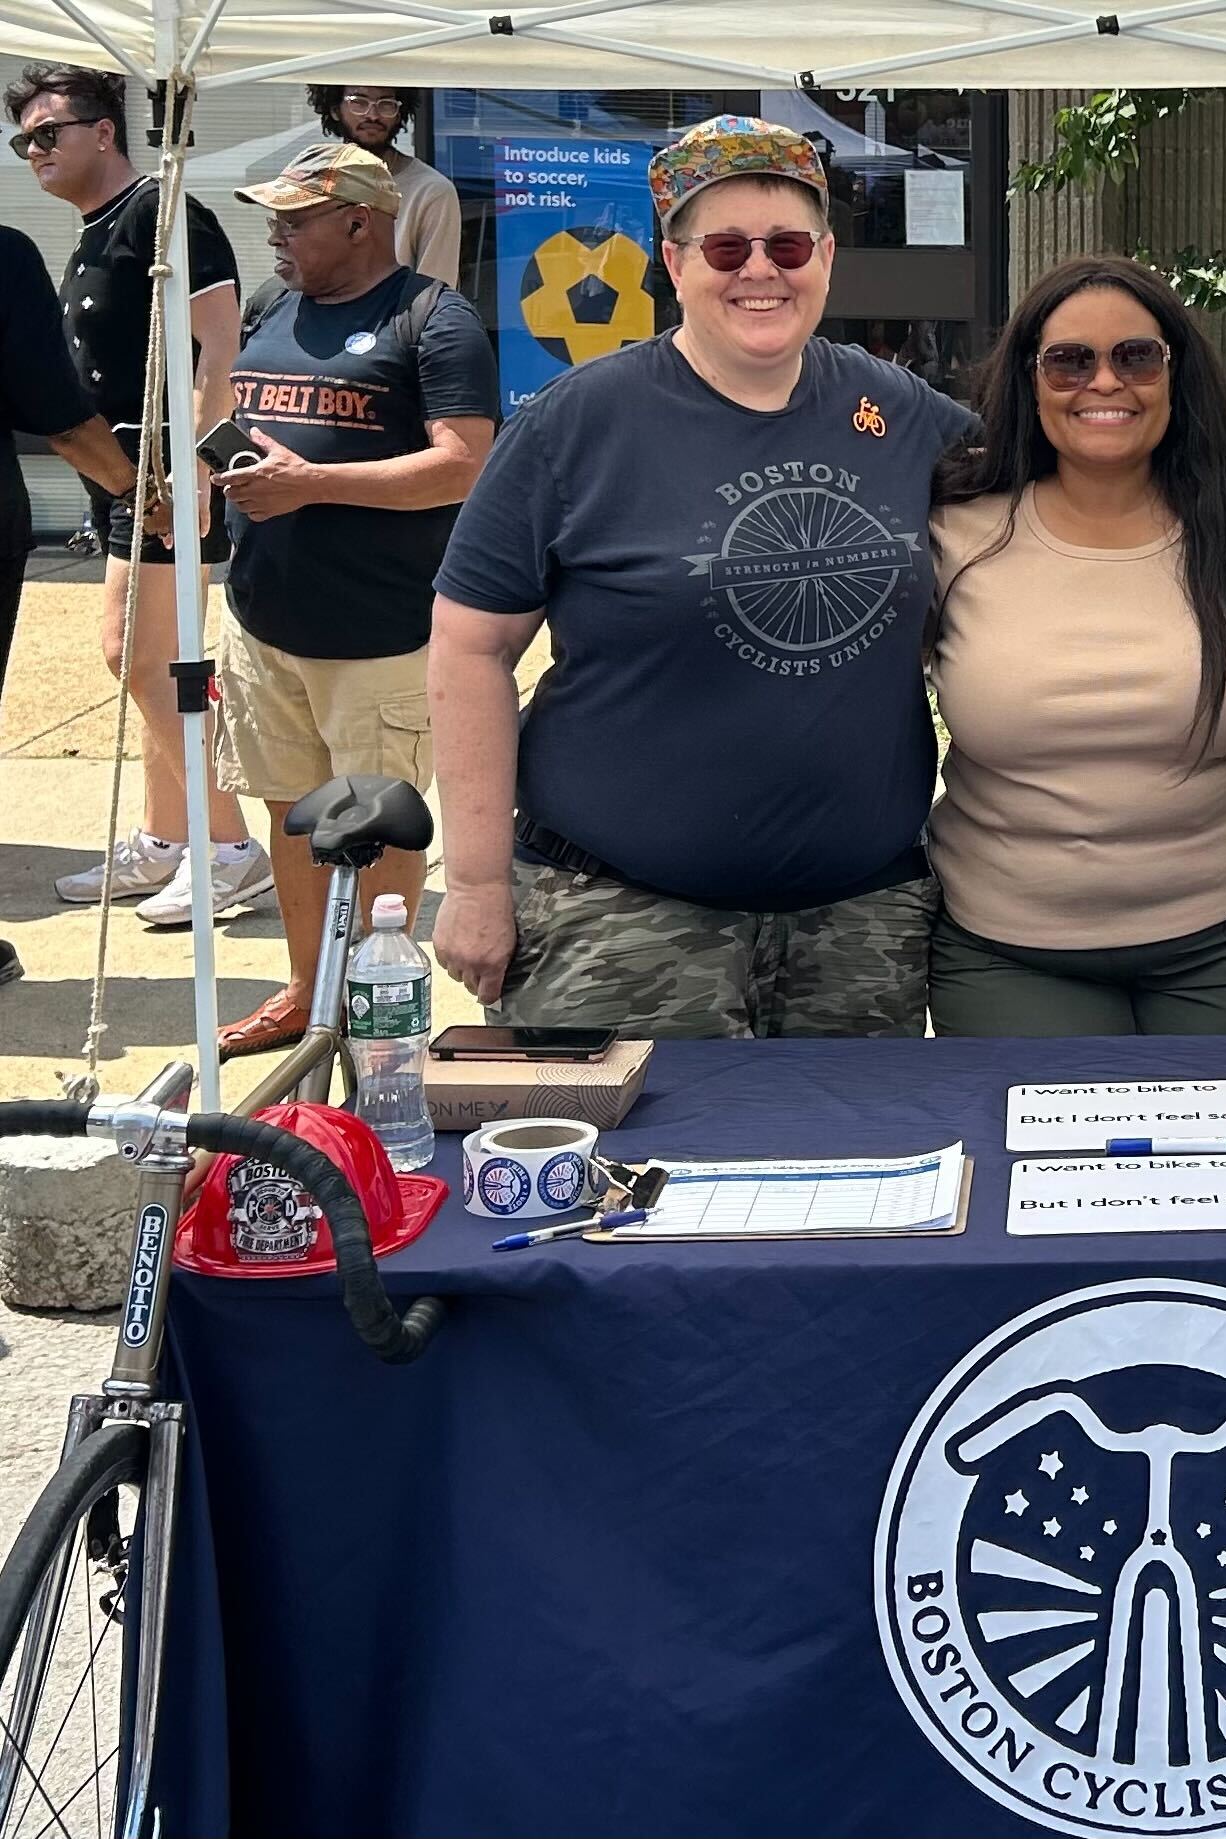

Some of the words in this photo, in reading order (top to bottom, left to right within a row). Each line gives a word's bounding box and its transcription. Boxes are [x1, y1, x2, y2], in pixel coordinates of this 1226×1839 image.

[504, 145, 590, 163] Introduce
[594, 147, 631, 165] kids
[504, 169, 524, 183] to
[528, 171, 588, 188] soccer,
[505, 191, 535, 206] not
[540, 191, 577, 208] risk.
[258, 383, 314, 414] BELT
[714, 461, 861, 506] BOSTON
[724, 559, 800, 576] STRENGTH
[824, 548, 898, 567] NUMBERS
[714, 623, 822, 677] CYCLISTS
[828, 605, 899, 668] UNION
[1105, 1086, 1131, 1094] to
[1137, 1085, 1185, 1093] bike
[459, 1101, 486, 1117] ME
[1020, 1115, 1063, 1124] But
[1084, 1114, 1146, 1123] don't
[1155, 1112, 1201, 1121] feel
[245, 1165, 290, 1181] BOSTO
[1037, 1163, 1105, 1171] want
[1114, 1162, 1142, 1170] to
[1149, 1160, 1201, 1169] bike
[249, 1200, 256, 1218] F
[285, 1199, 295, 1217] D
[1019, 1200, 1068, 1210] But
[1090, 1196, 1160, 1207] don't
[1169, 1195, 1219, 1205] feel
[238, 1233, 255, 1250] FIRE
[255, 1231, 304, 1252] DEPARTMENT
[126, 1215, 162, 1340] BENOTTO
[906, 1568, 1036, 1773] BOSTON
